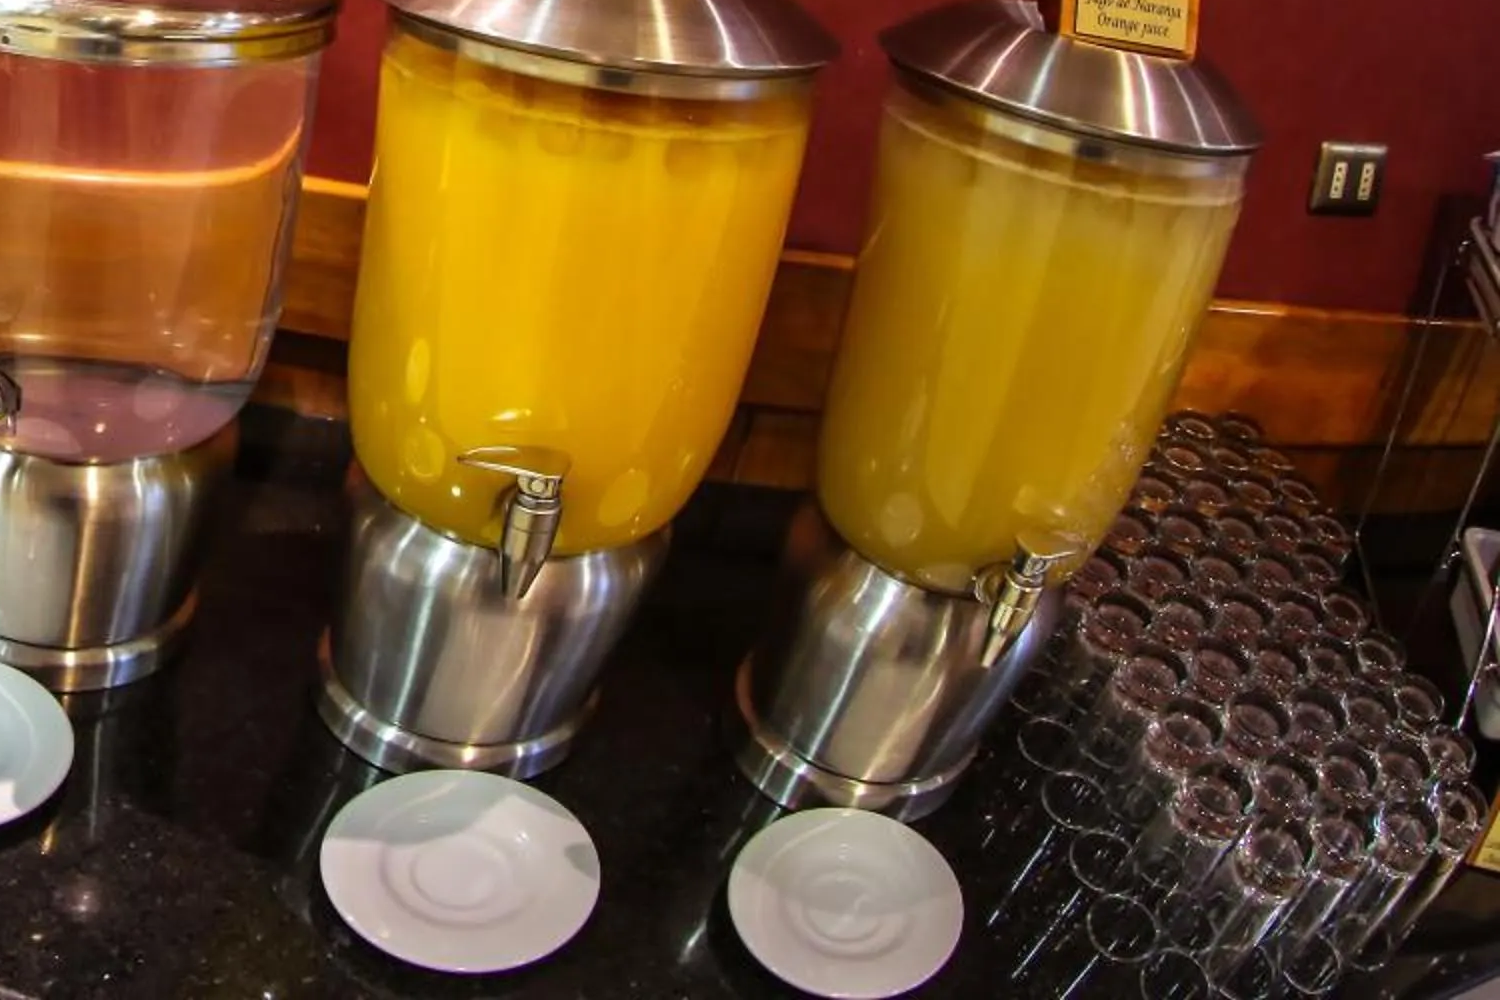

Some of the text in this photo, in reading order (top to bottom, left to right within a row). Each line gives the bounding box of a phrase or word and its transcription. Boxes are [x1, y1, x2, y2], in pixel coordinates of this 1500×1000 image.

[1133, 0, 1182, 22] Naranja
[1097, 12, 1170, 38] Orange juice
